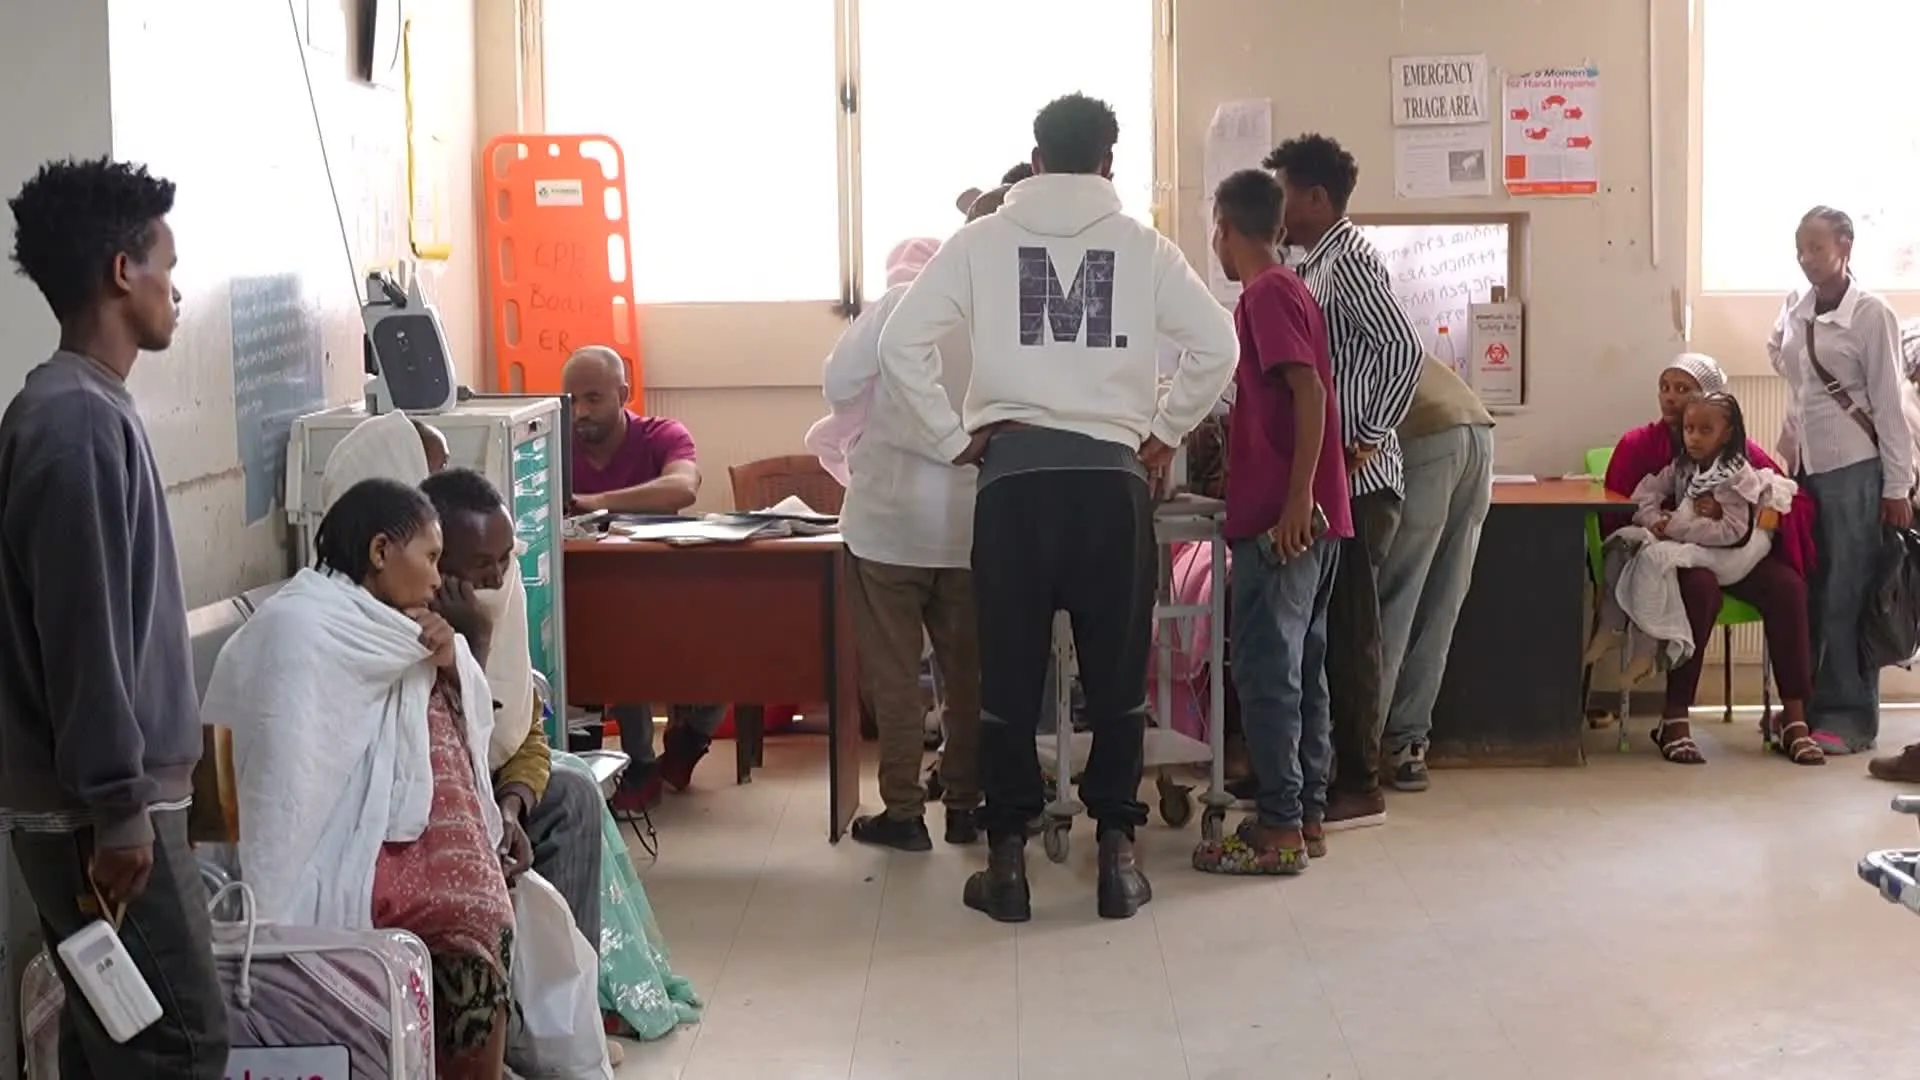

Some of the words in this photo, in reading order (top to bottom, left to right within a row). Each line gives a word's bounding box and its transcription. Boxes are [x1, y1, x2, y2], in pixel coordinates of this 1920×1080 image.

[1402, 63, 1474, 87] EMERGENCY
[1523, 79, 1551, 88] Hand
[1554, 79, 1597, 90] Hygiene
[1403, 96, 1447, 119] TRIAGE
[1448, 95, 1479, 117] AREA
[1018, 246, 1128, 348] M.
[1478, 323, 1501, 332] Safety
[538, 328, 573, 357] ER
